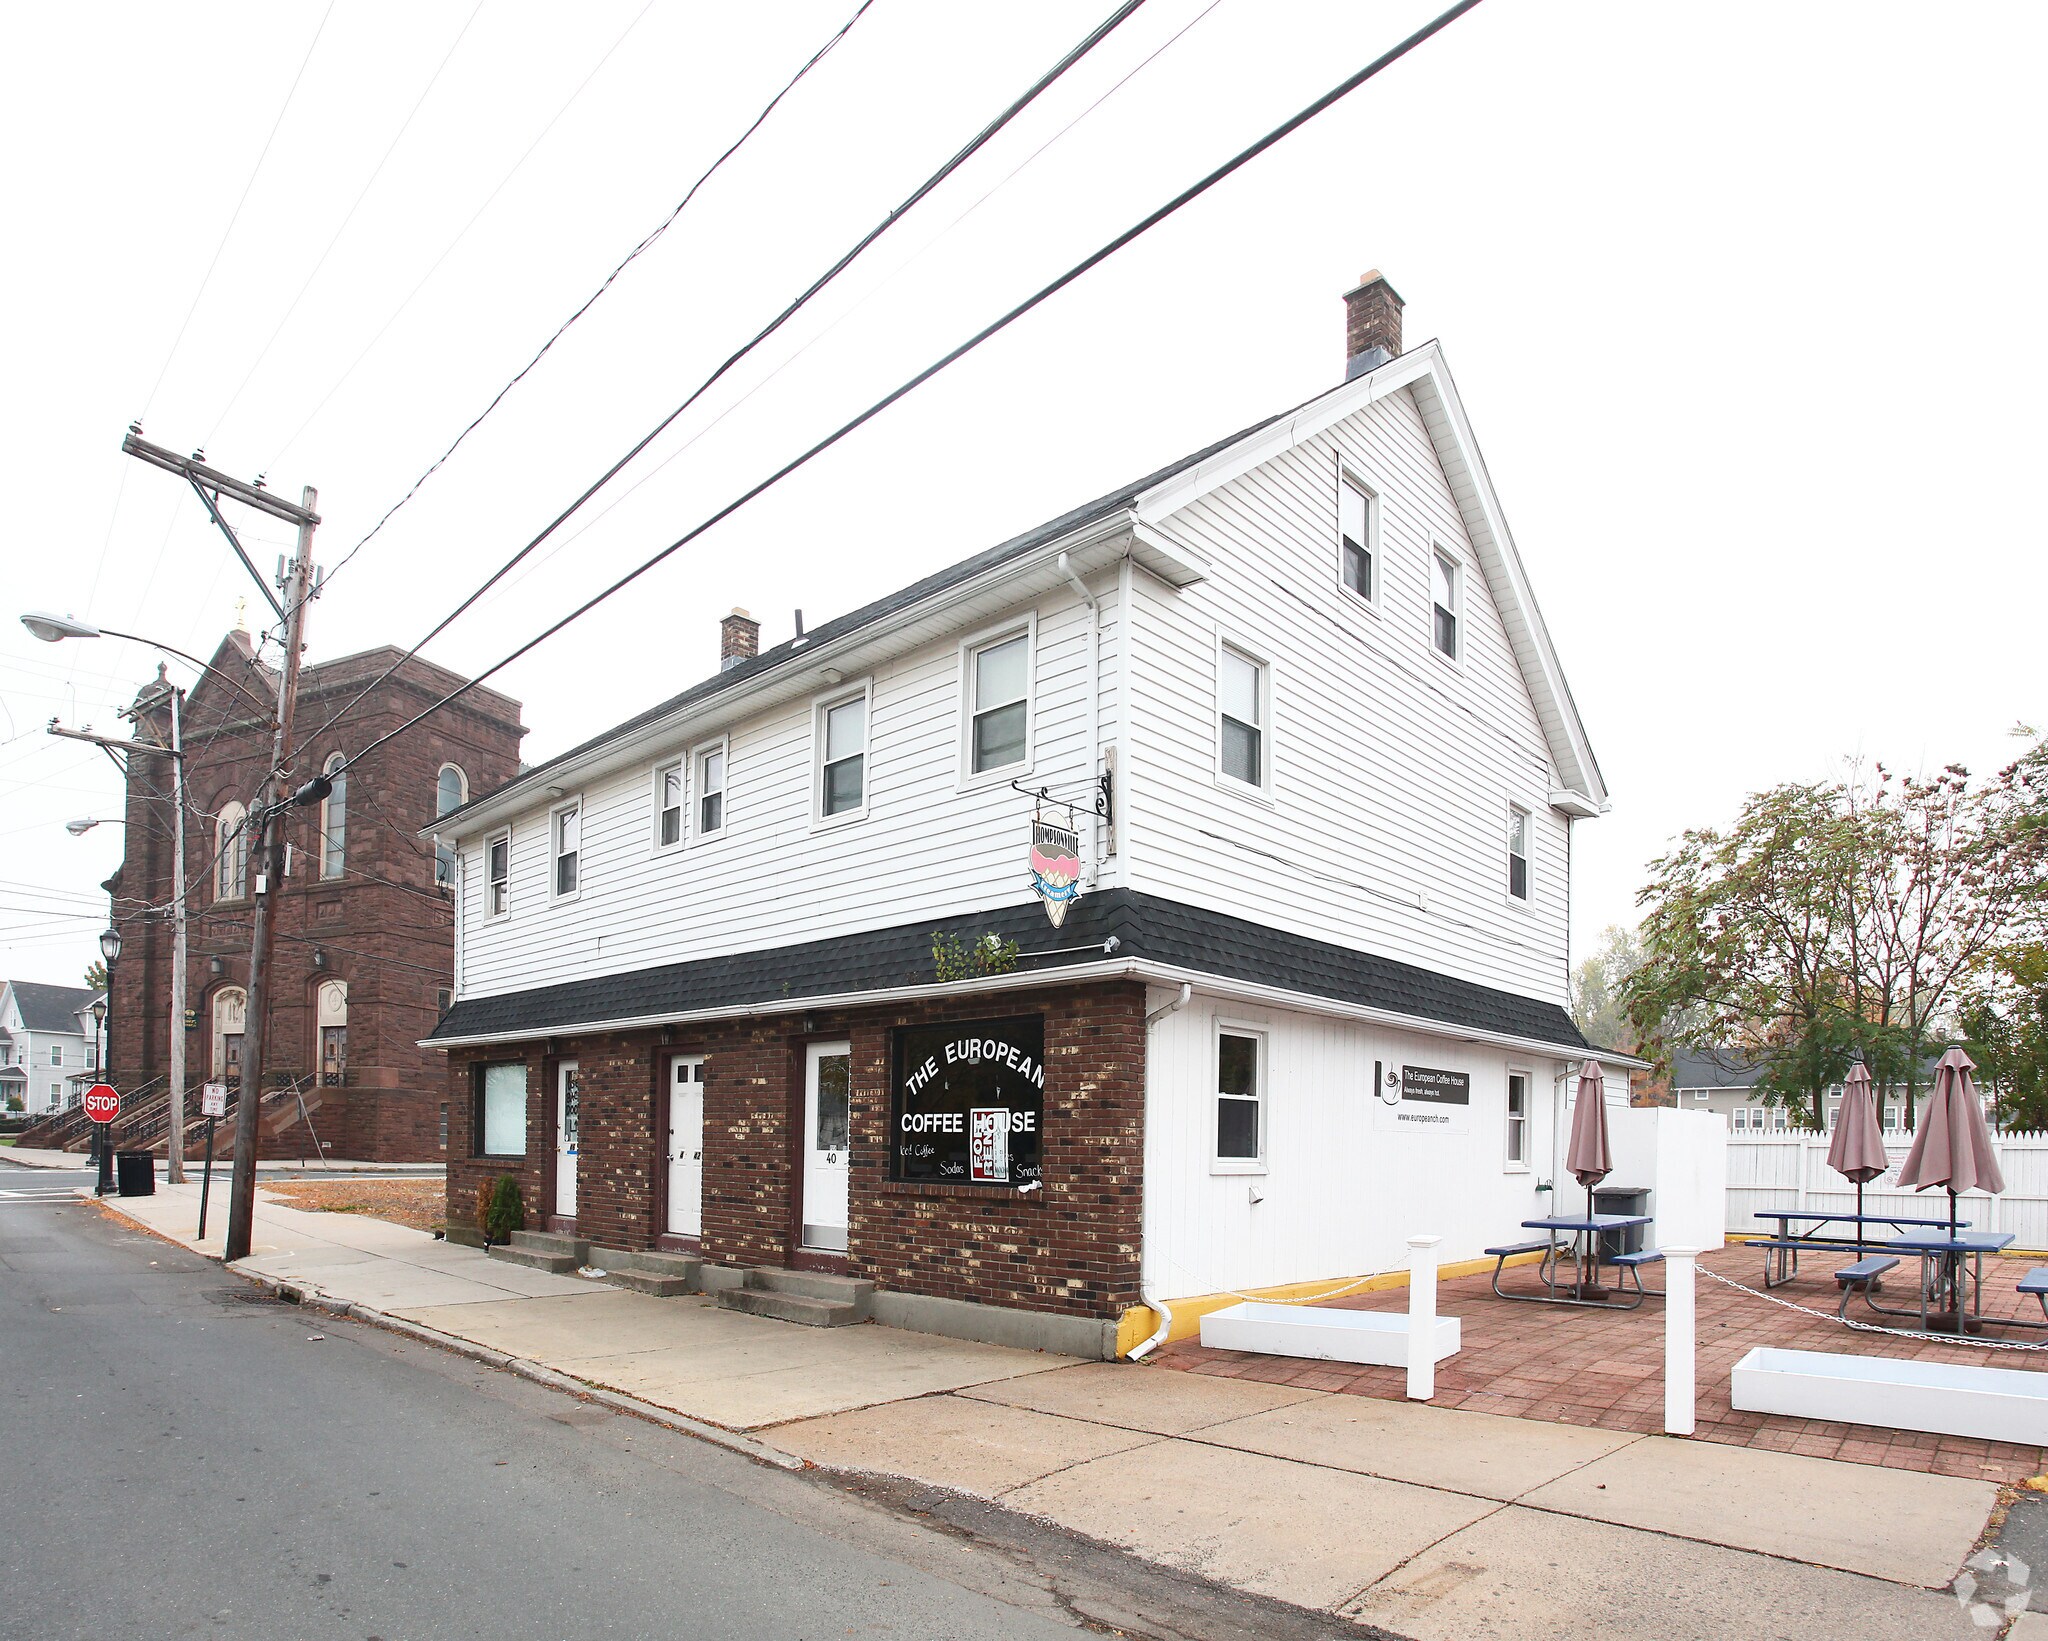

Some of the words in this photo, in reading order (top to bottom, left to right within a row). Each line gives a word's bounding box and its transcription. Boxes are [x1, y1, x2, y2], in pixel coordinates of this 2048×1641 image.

[1032, 820, 1079, 857] THOMPSONVILLE
[1040, 880, 1071, 898] Creamery
[905, 1056, 939, 1095] THE
[944, 1038, 1045, 1090] EUROPEAN
[1404, 1070, 1413, 1080] The
[1414, 1071, 1436, 1084] European
[1436, 1073, 1450, 1085] Coffee
[1450, 1076, 1464, 1086] House
[87, 1096, 118, 1111] STOP
[206, 1094, 224, 1102] PARKING
[901, 1113, 963, 1133] COFFEE
[1397, 1113, 1450, 1124] www.europeanch.com
[826, 1152, 837, 1164] 40
[915, 1144, 935, 1158] Coffee
[939, 1160, 965, 1176] Sodas
